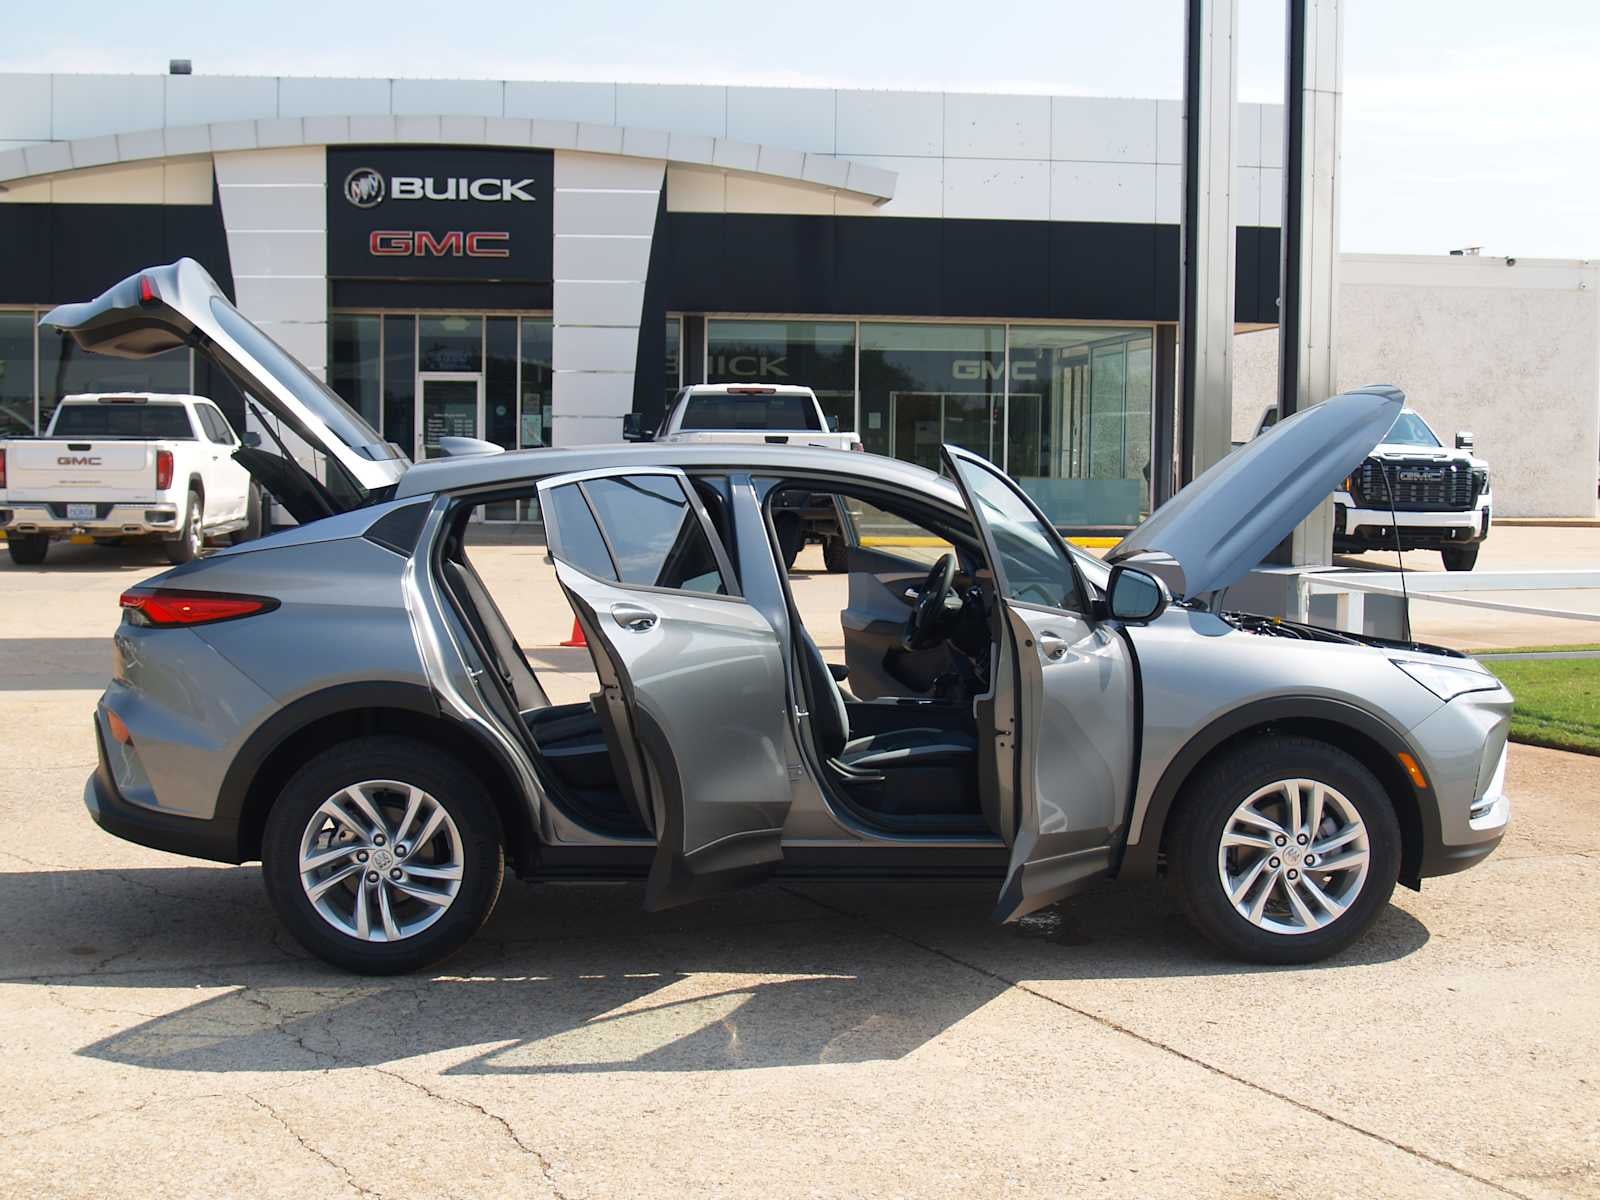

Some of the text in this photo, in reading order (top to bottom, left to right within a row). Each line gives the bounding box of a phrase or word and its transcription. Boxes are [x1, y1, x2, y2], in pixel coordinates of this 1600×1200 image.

[391, 177, 536, 201] BUICK
[369, 230, 510, 257] GMC
[952, 360, 1037, 380] GMC
[57, 456, 103, 466] GMC
[1399, 471, 1443, 481] GMC
